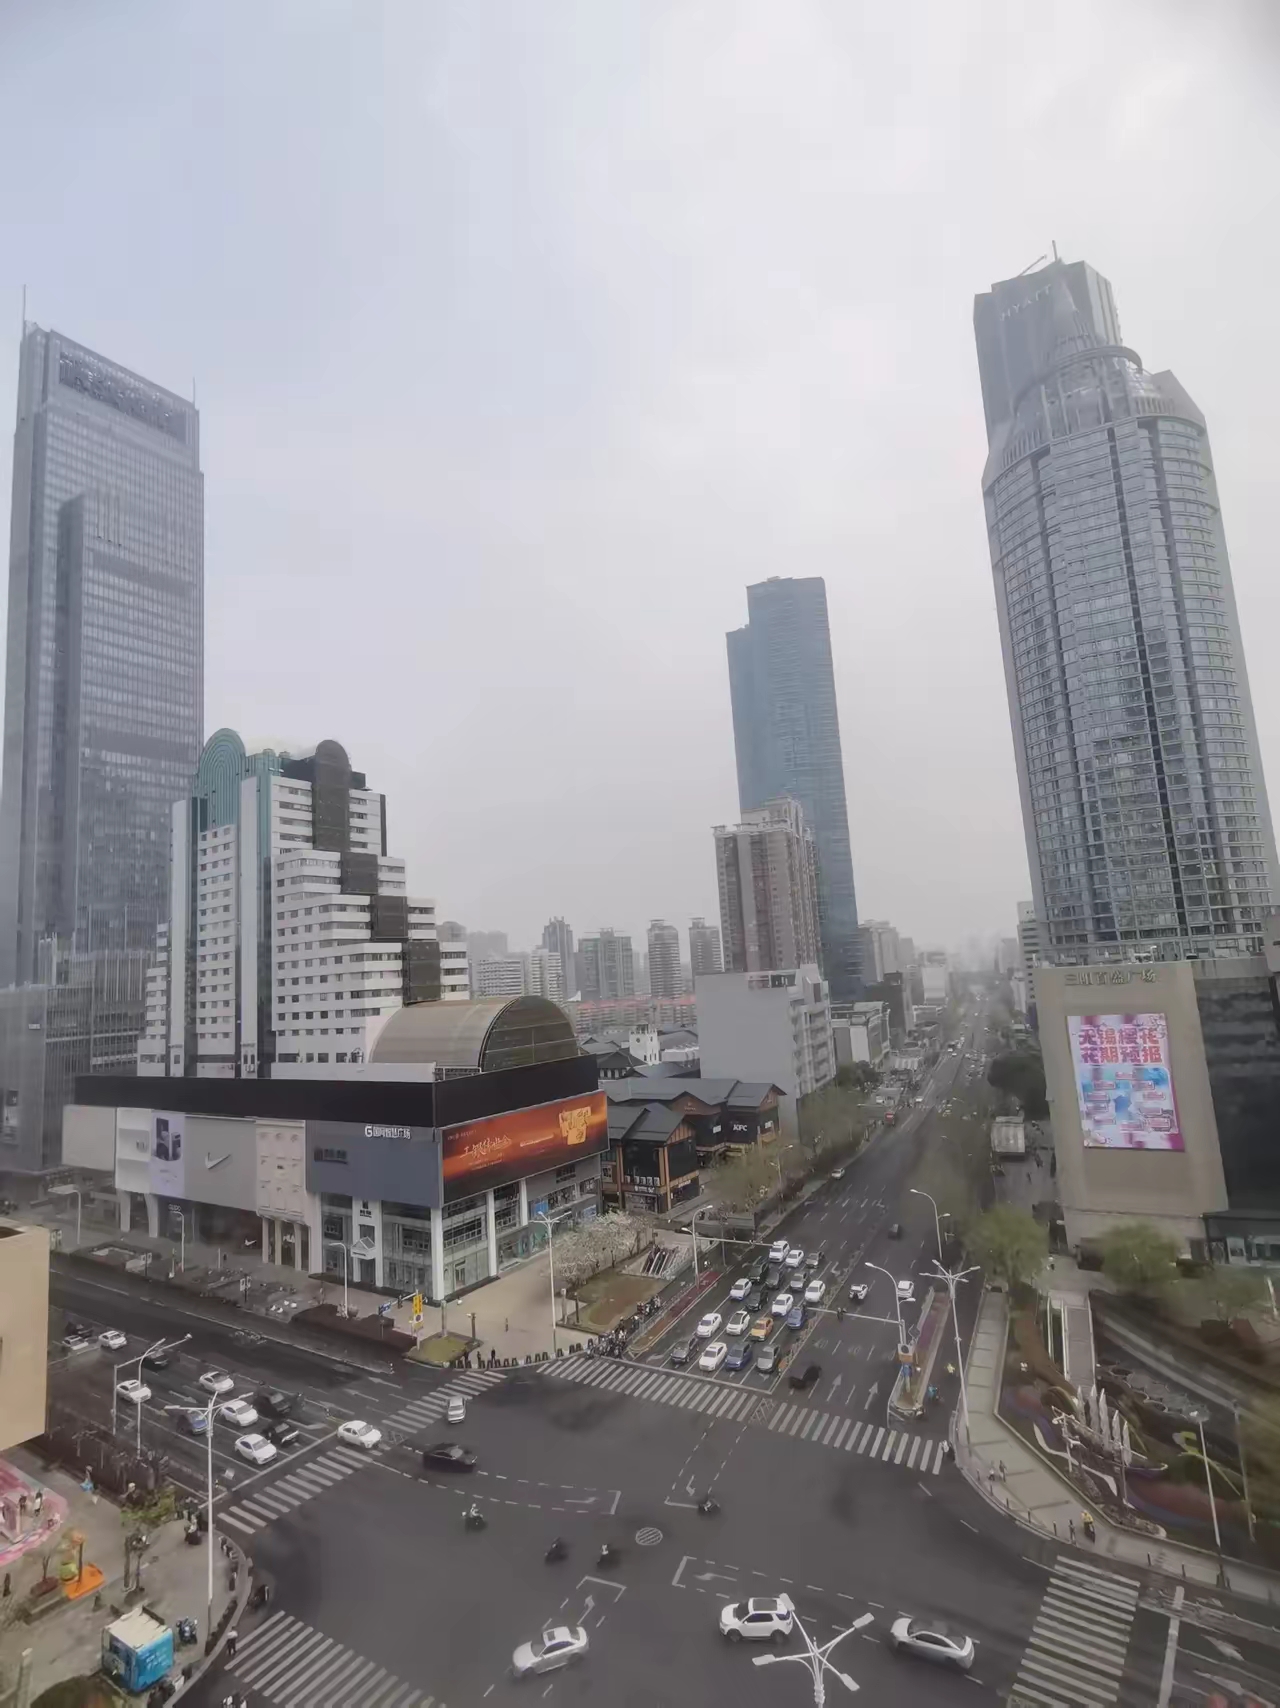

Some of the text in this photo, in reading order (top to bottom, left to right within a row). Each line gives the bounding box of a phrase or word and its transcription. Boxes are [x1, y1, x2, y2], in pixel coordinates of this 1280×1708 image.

[1000, 284, 1051, 321] HYATT
[1080, 1046, 1163, 1063] 花期预报
[732, 1124, 748, 1132] KFC
